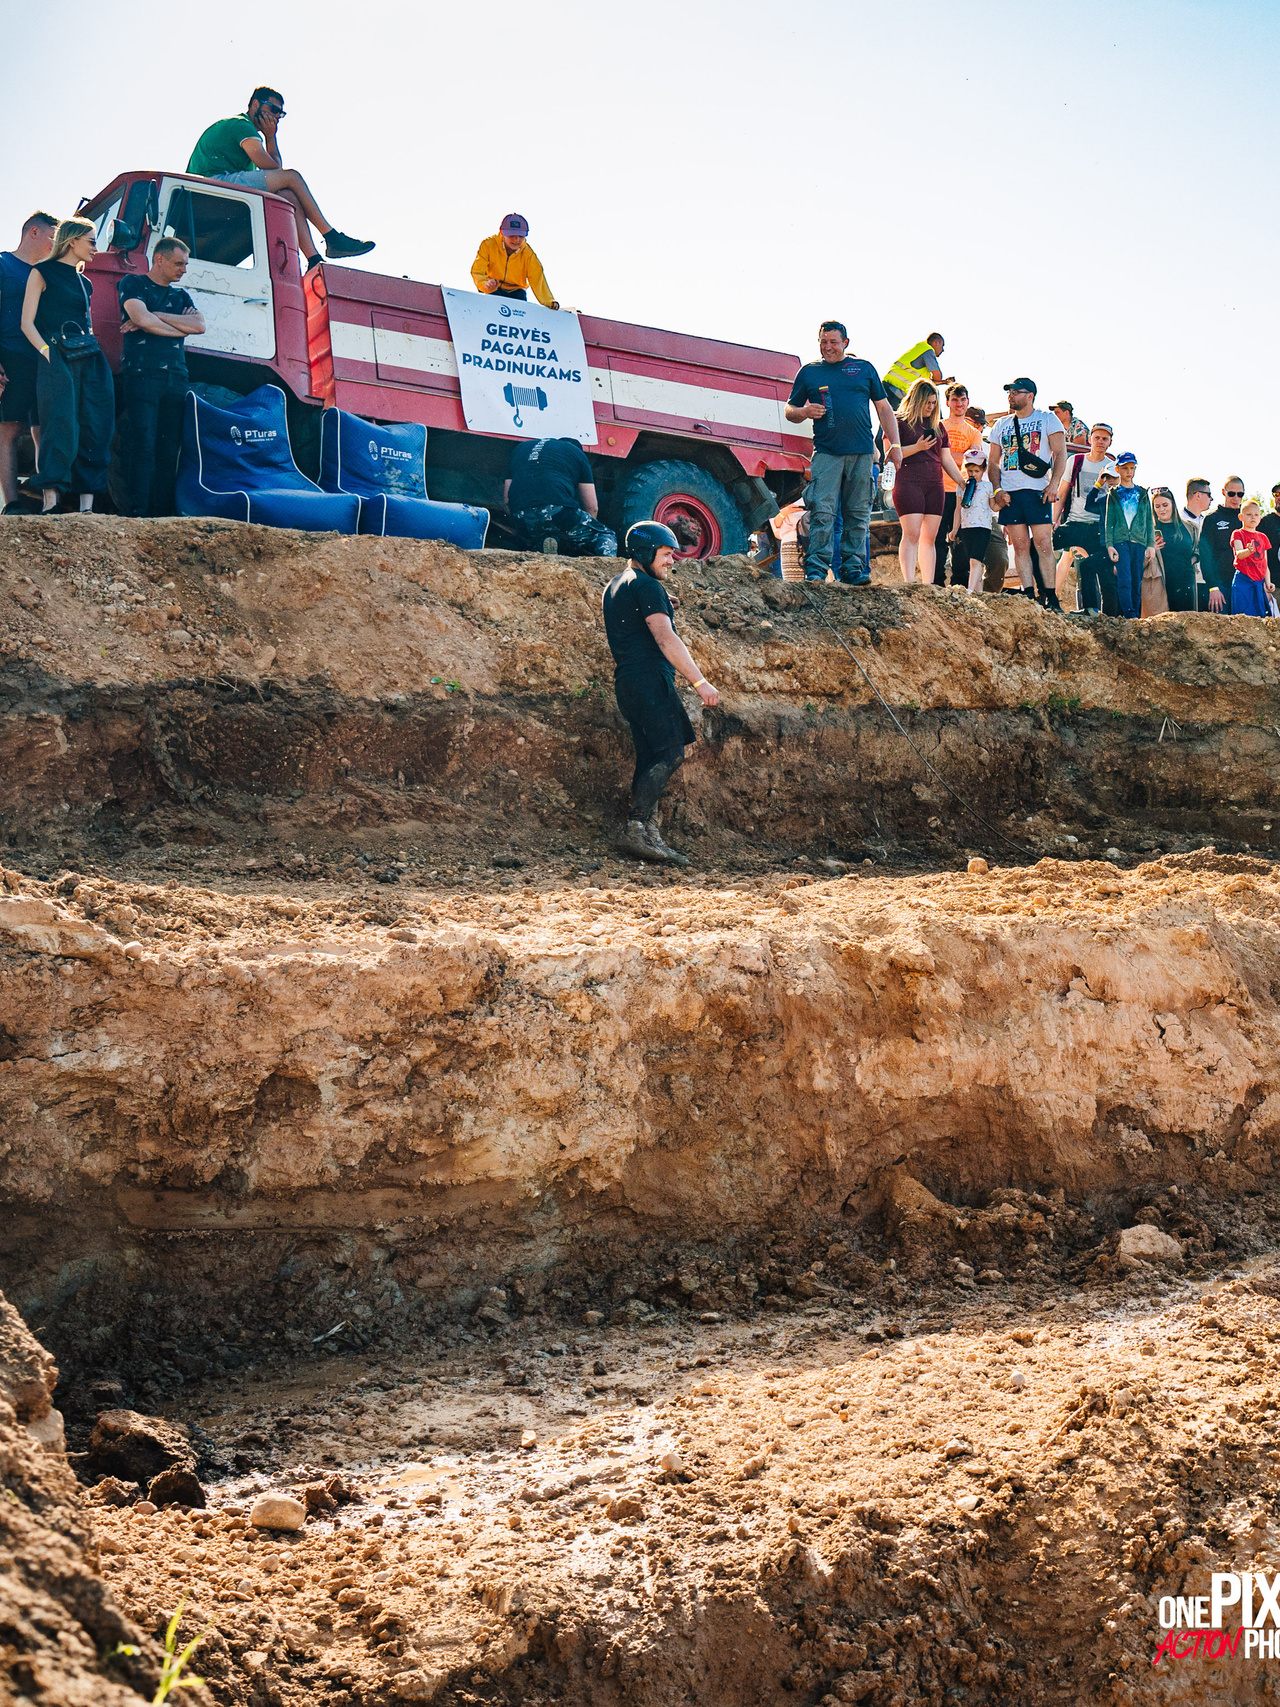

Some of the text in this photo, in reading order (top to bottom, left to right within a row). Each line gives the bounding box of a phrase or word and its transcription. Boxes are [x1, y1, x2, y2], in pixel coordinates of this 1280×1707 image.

[486, 323, 551, 344] GERVĖS
[481, 339, 559, 362] PAGALBA
[462, 353, 582, 383] PRADINUKAMS
[1003, 420, 1042, 431] JUTICE
[245, 430, 277, 438] PTuras
[381, 447, 412, 459] PTuras
